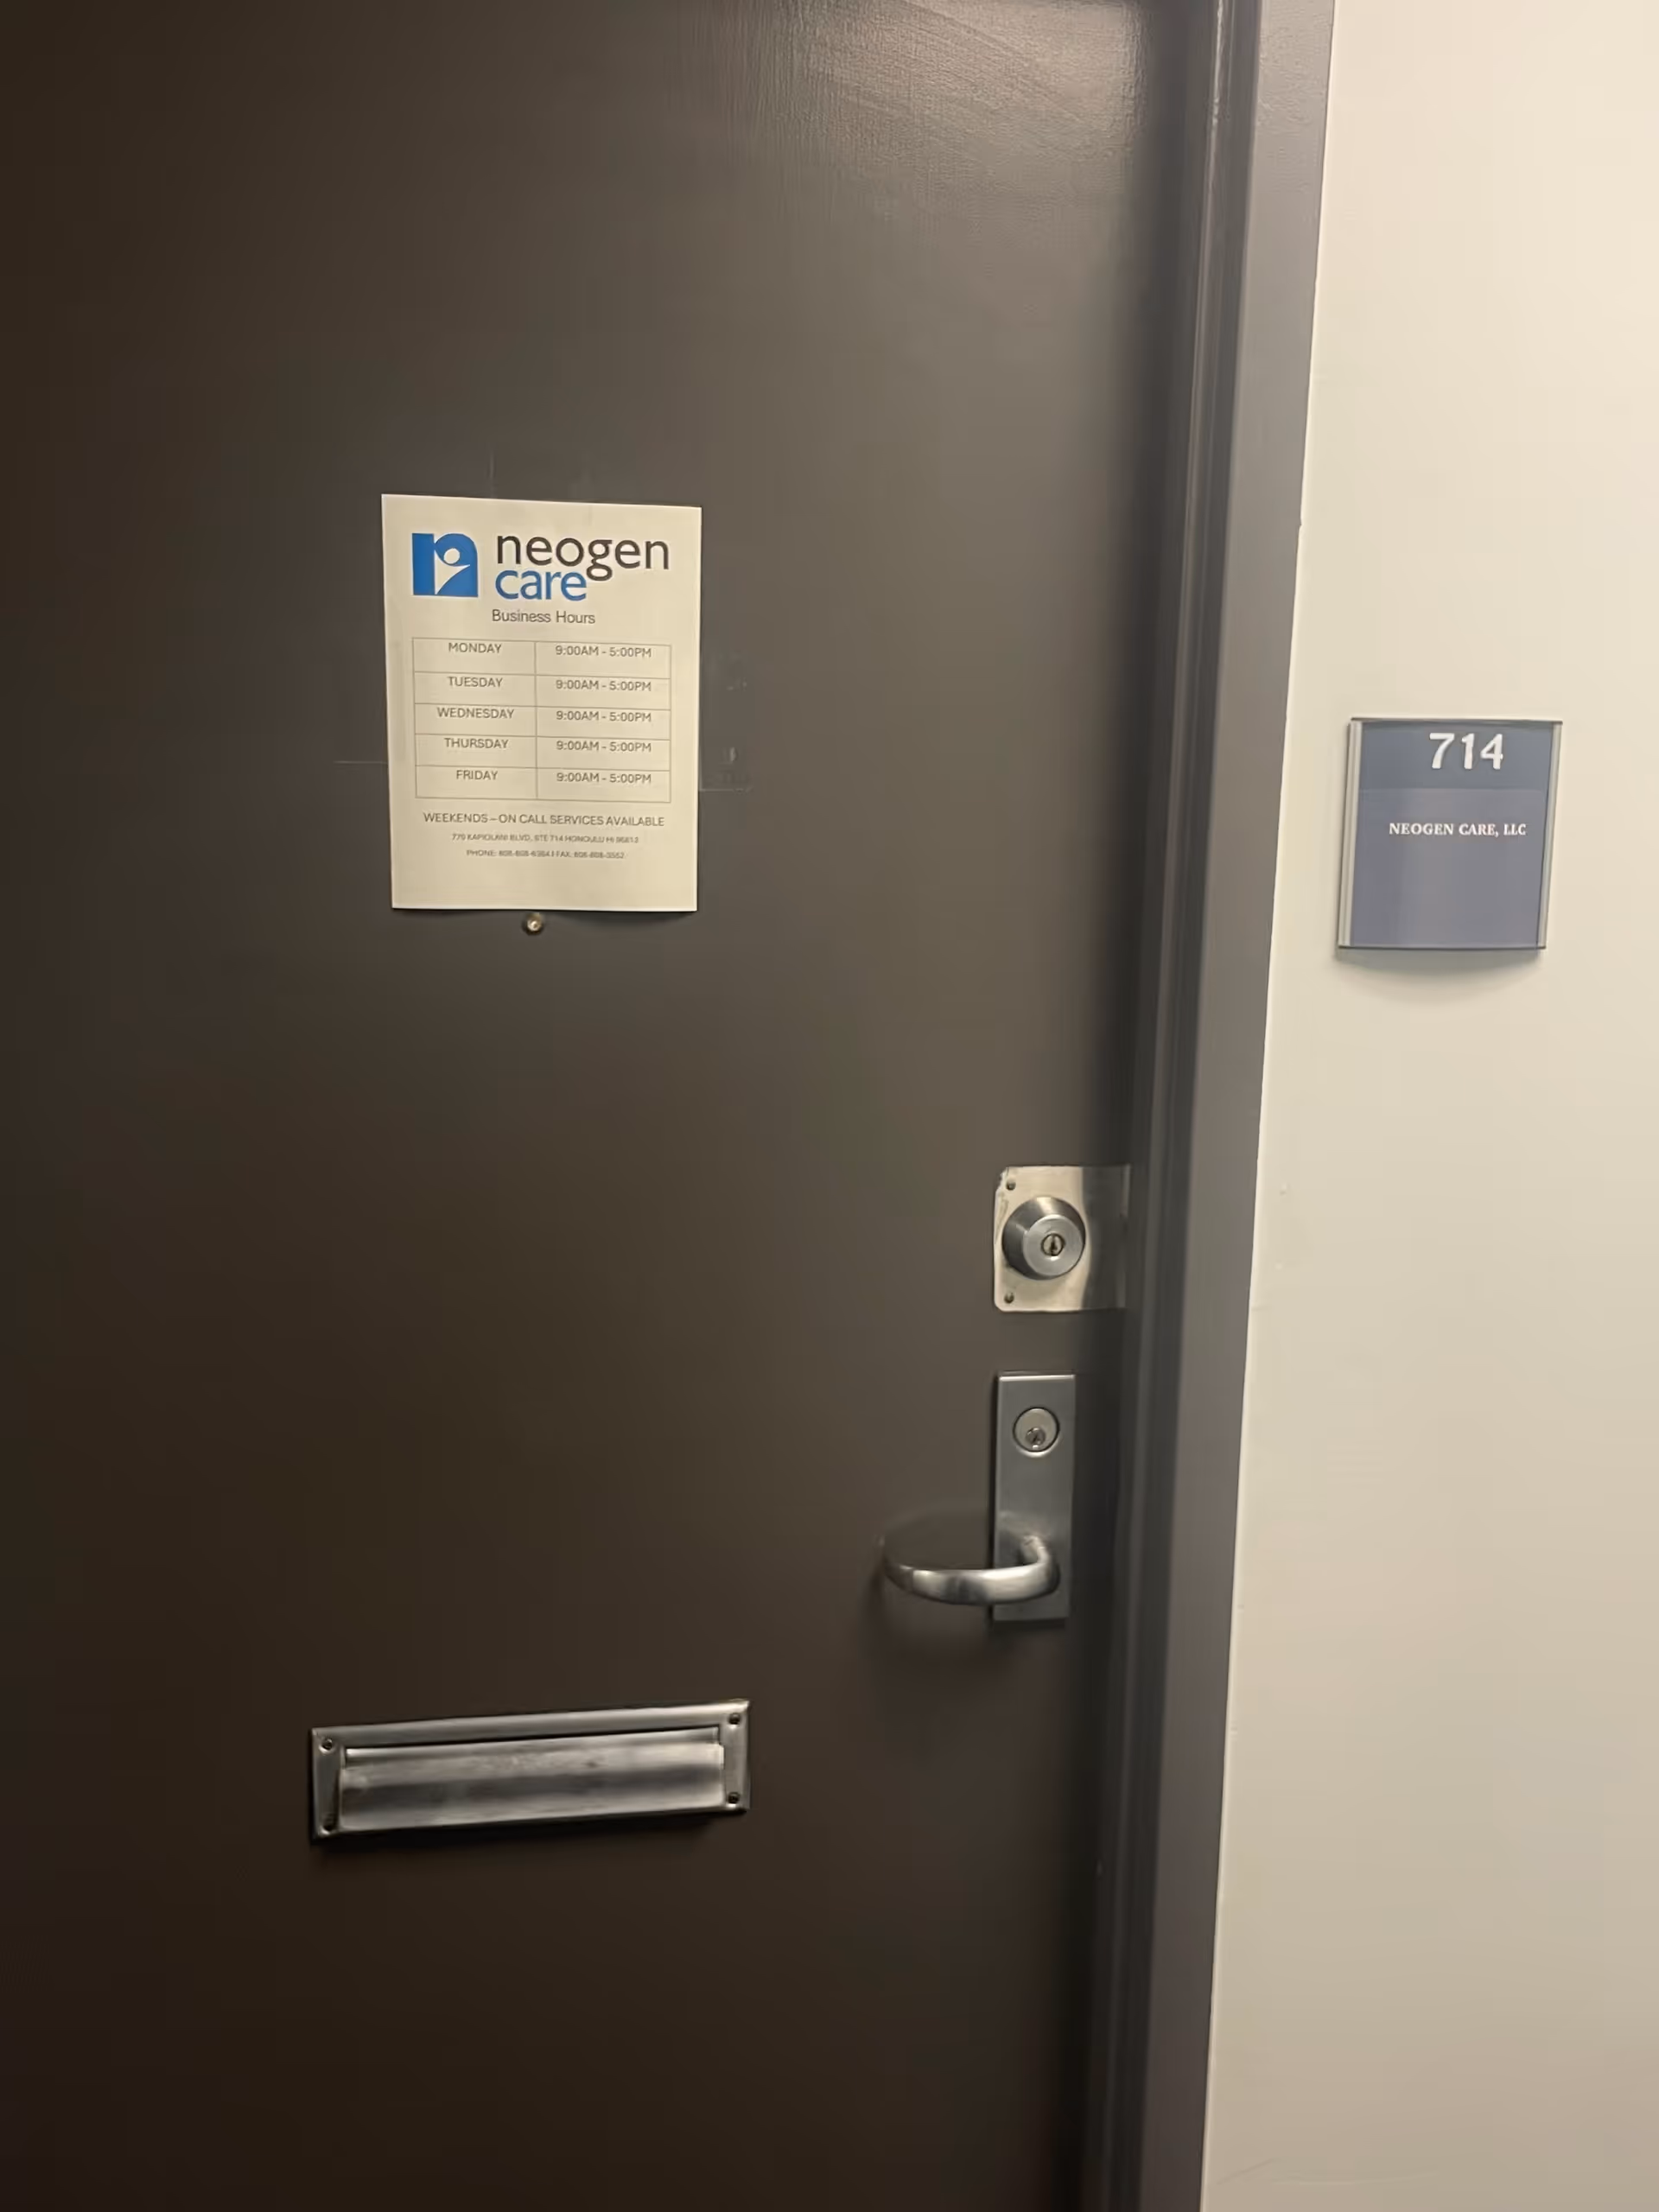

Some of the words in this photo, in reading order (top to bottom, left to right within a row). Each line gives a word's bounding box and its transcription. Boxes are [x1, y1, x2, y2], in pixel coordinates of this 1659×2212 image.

[497, 535, 670, 582] neogen
[495, 570, 588, 601] care
[492, 609, 551, 623] Business
[556, 610, 595, 625] Hours
[448, 642, 502, 654] MONDAY
[556, 645, 599, 657] 9:00AM
[609, 647, 652, 658] 5:00PM
[448, 676, 503, 688] TUESDAY
[556, 680, 599, 690] 9:00AM
[609, 681, 652, 691] 5:00PM
[436, 707, 514, 719] WEDNESDAY
[556, 710, 599, 721] 9:00AM
[609, 712, 652, 722] 5:00PM
[444, 737, 509, 749] THURSDAY
[556, 741, 599, 751] 9:00AM
[609, 741, 652, 752] 5:00PM
[1429, 732, 1503, 770] 714
[456, 770, 499, 780] FRIDAY
[556, 772, 599, 783] 9:00AM
[609, 773, 652, 784] 5:00PM
[423, 812, 488, 823] WEEKENDS
[499, 814, 517, 823] ON
[519, 814, 547, 824] CALL
[550, 815, 604, 825] SERVICES
[606, 816, 664, 827] AVAILABLE
[1389, 823, 1454, 836] NEOGEN
[1459, 823, 1499, 837] CARE,
[1503, 823, 1527, 836] LLC
